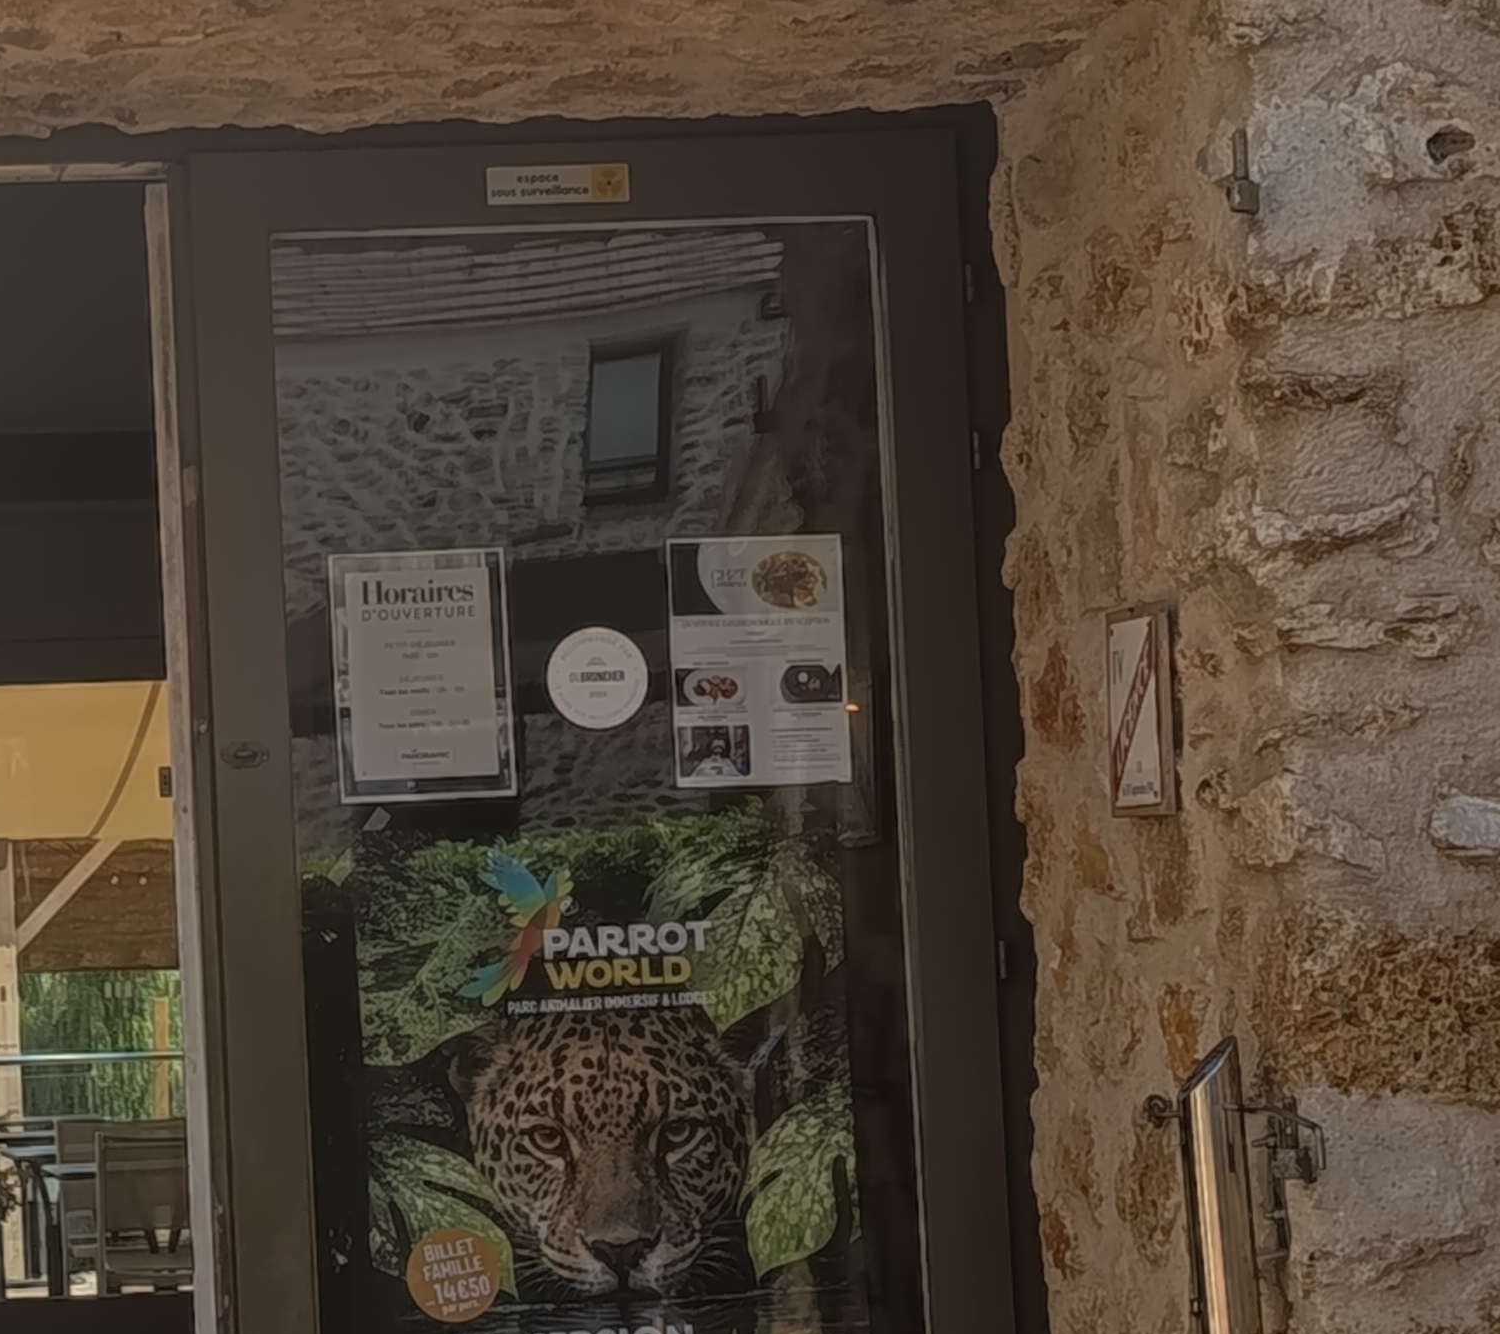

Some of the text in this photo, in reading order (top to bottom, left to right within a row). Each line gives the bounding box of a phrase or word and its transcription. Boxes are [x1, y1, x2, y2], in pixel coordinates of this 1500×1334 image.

[490, 184, 589, 198] sous surveillance
[516, 172, 559, 185] espace
[361, 579, 474, 606] Horaires
[361, 605, 476, 622] D'OUVERTURE
[542, 919, 714, 960] PARROT
[542, 955, 693, 992] WORLD
[507, 999, 538, 1016] PARC
[539, 995, 603, 1014] ANIMALIER
[603, 992, 659, 1010] IMMERSIF
[422, 1237, 475, 1263] BILLET
[422, 1254, 484, 1283] FAMILLE
[433, 1274, 491, 1305] 14€50
